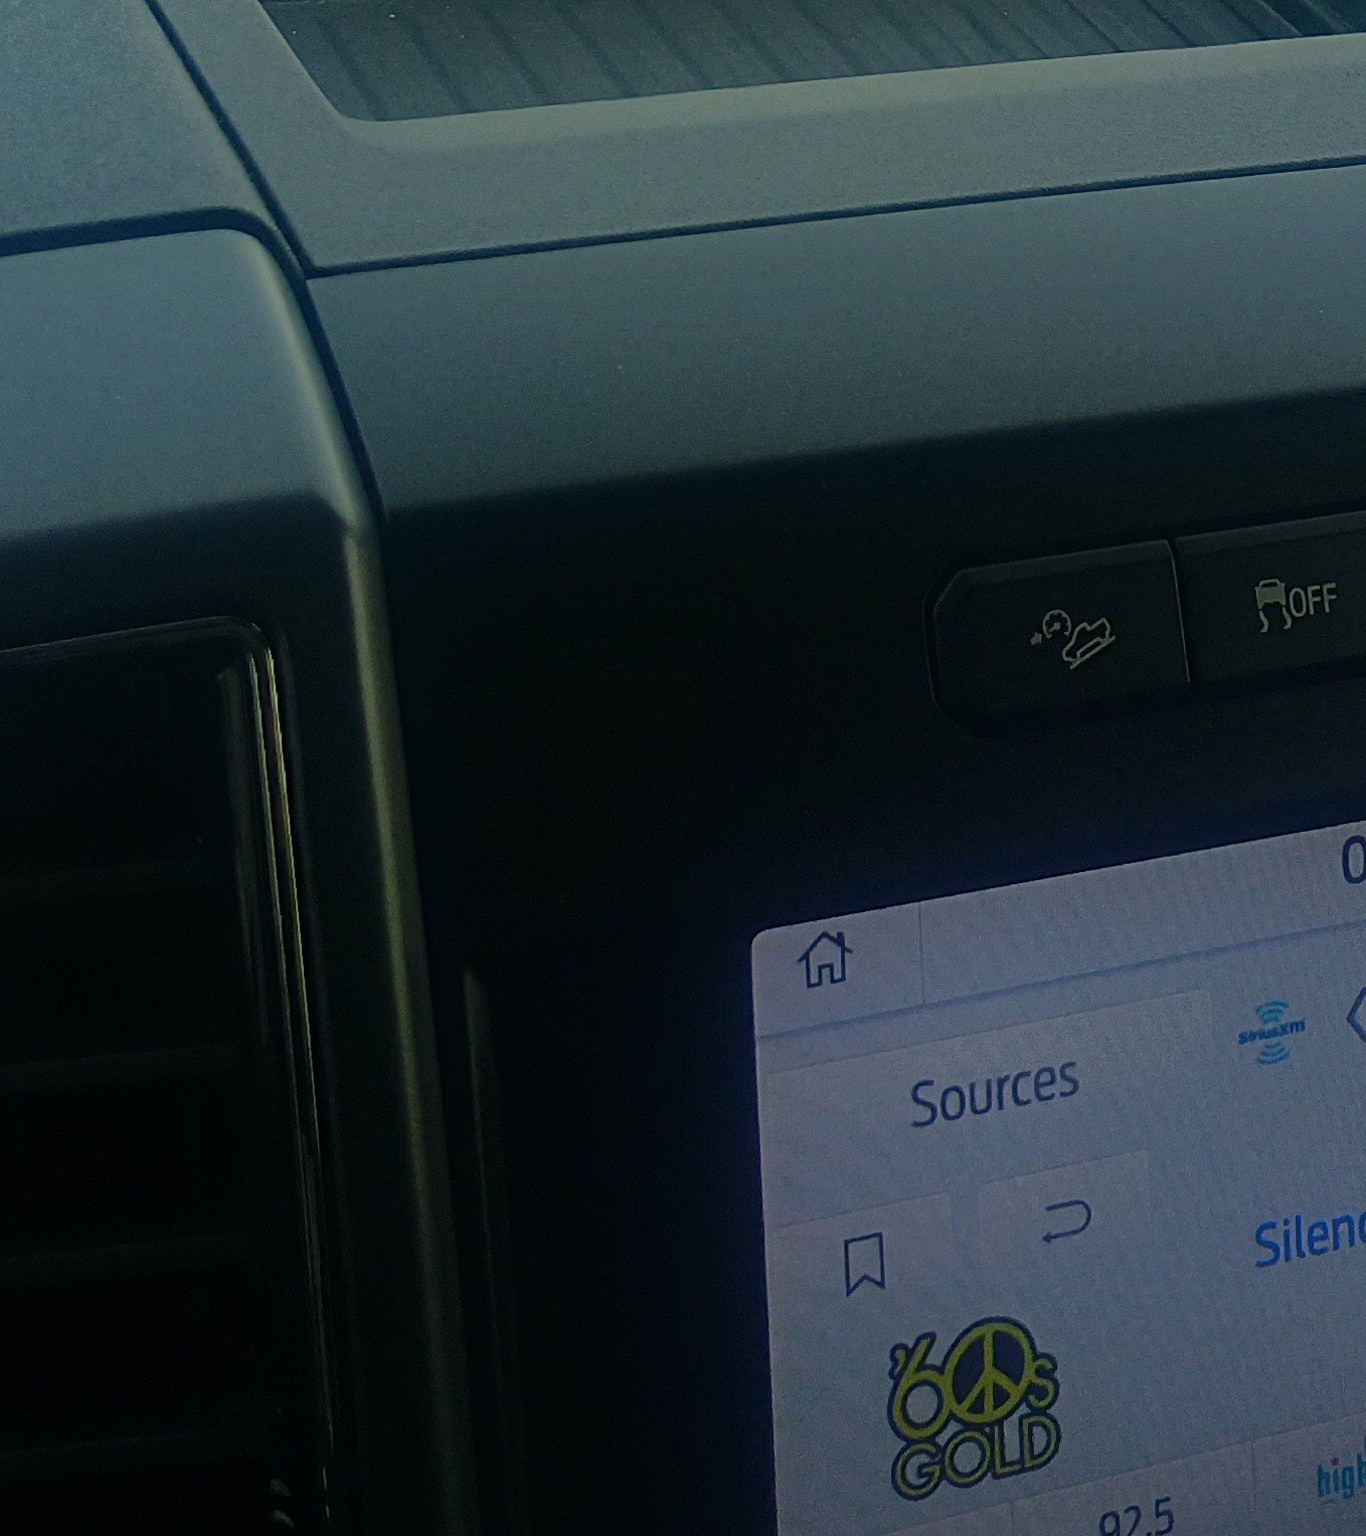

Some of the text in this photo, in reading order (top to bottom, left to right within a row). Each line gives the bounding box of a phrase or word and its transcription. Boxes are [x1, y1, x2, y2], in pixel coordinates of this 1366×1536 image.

[1289, 582, 1337, 618] OFF
[910, 1061, 1080, 1129] Sources
[891, 1413, 1062, 1501] GOLD
[1099, 1496, 1174, 1536] 92.5
